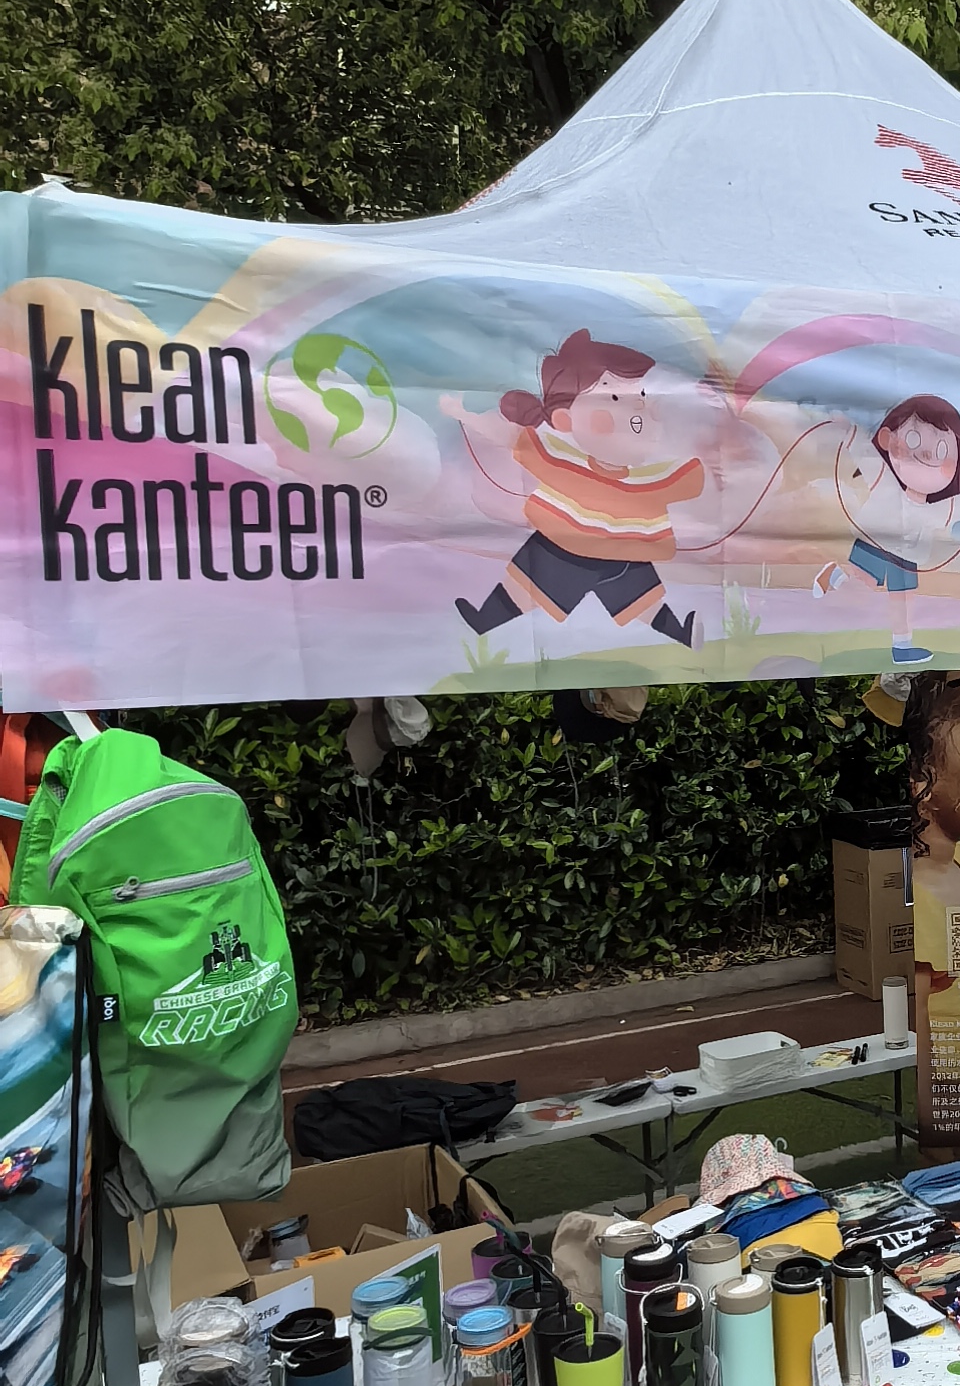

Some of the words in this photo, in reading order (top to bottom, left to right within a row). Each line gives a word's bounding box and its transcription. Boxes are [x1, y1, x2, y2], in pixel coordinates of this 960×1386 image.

[28, 304, 257, 444] klean
[139, 971, 292, 1046] RACING
[159, 989, 219, 1009] CHINESE
